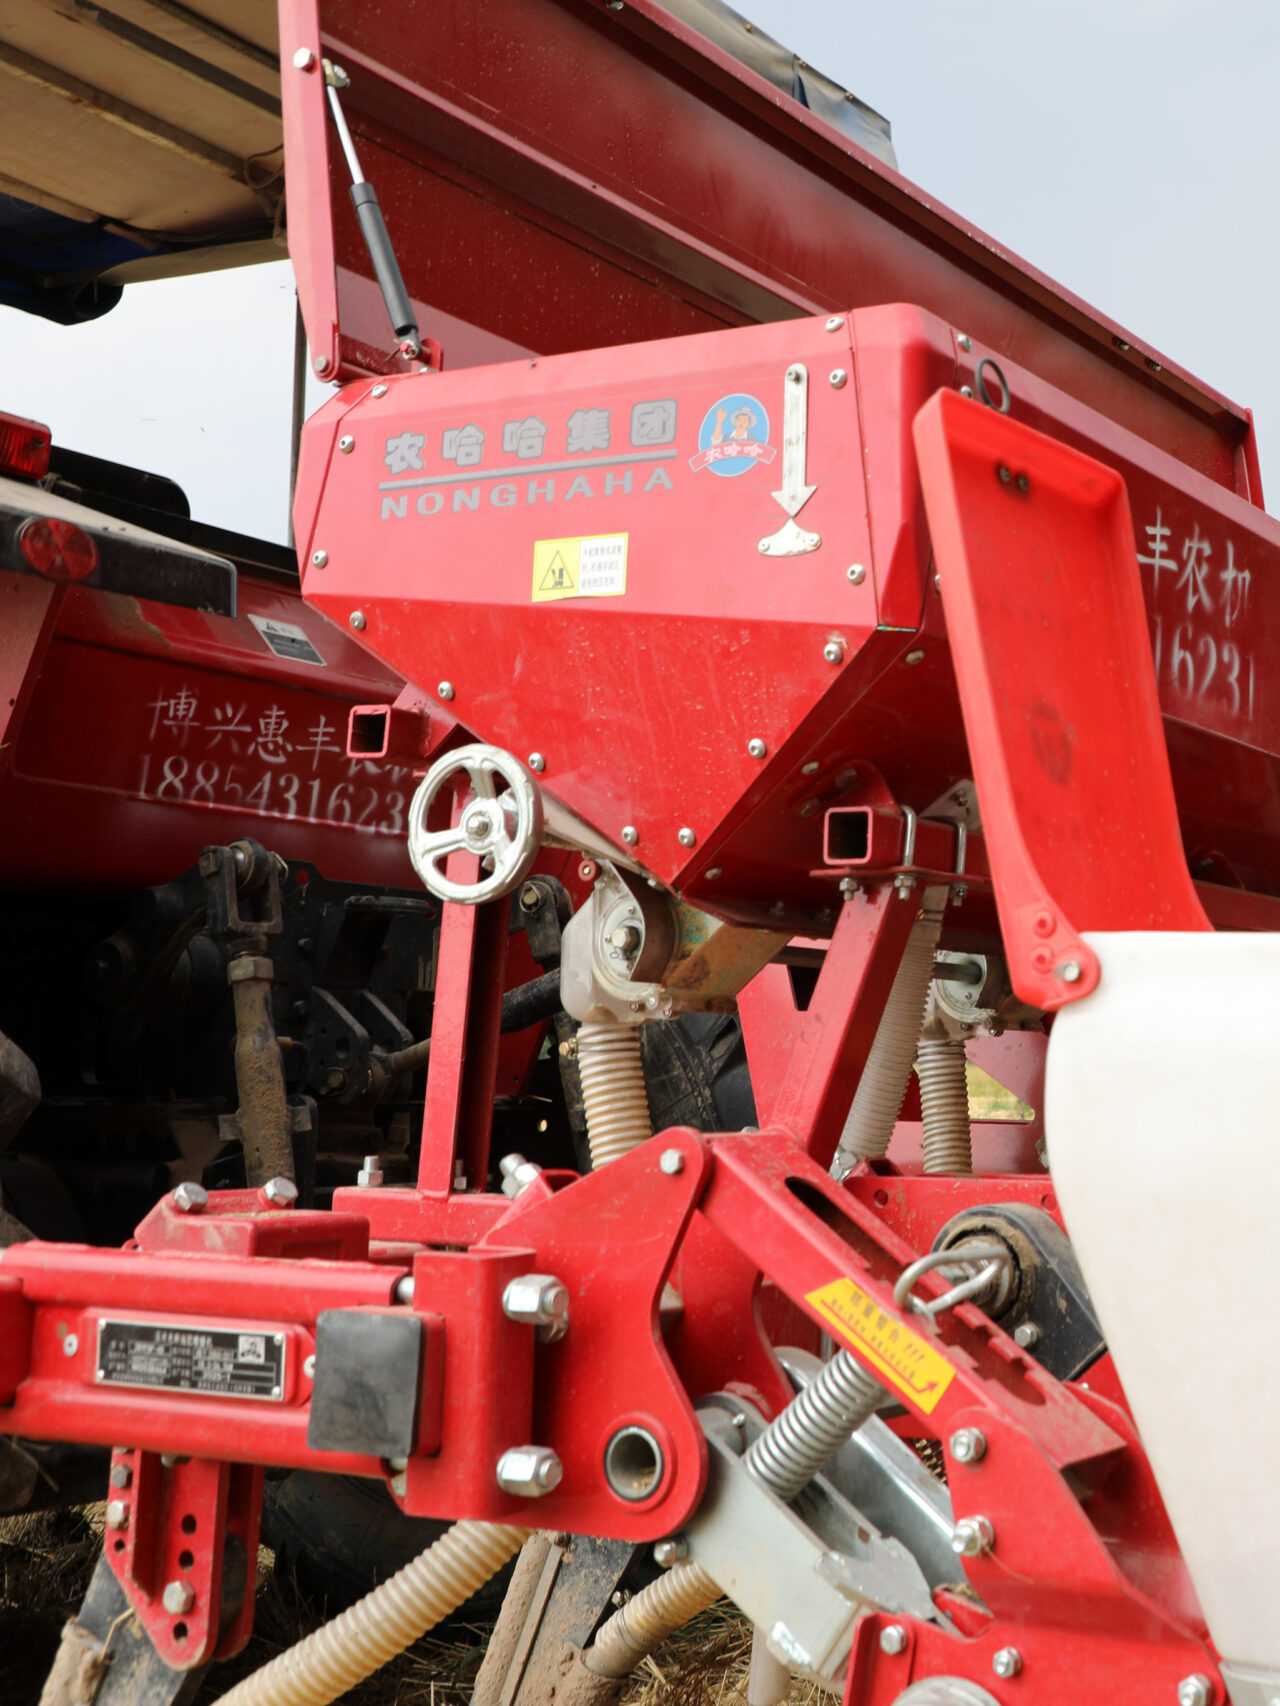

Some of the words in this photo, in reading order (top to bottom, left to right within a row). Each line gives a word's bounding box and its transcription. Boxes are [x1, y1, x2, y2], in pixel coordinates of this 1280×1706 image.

[383, 398, 678, 476] 农哈哈集团
[381, 466, 674, 521] NONGHAHA
[146, 684, 408, 784] 博兴惠丰
